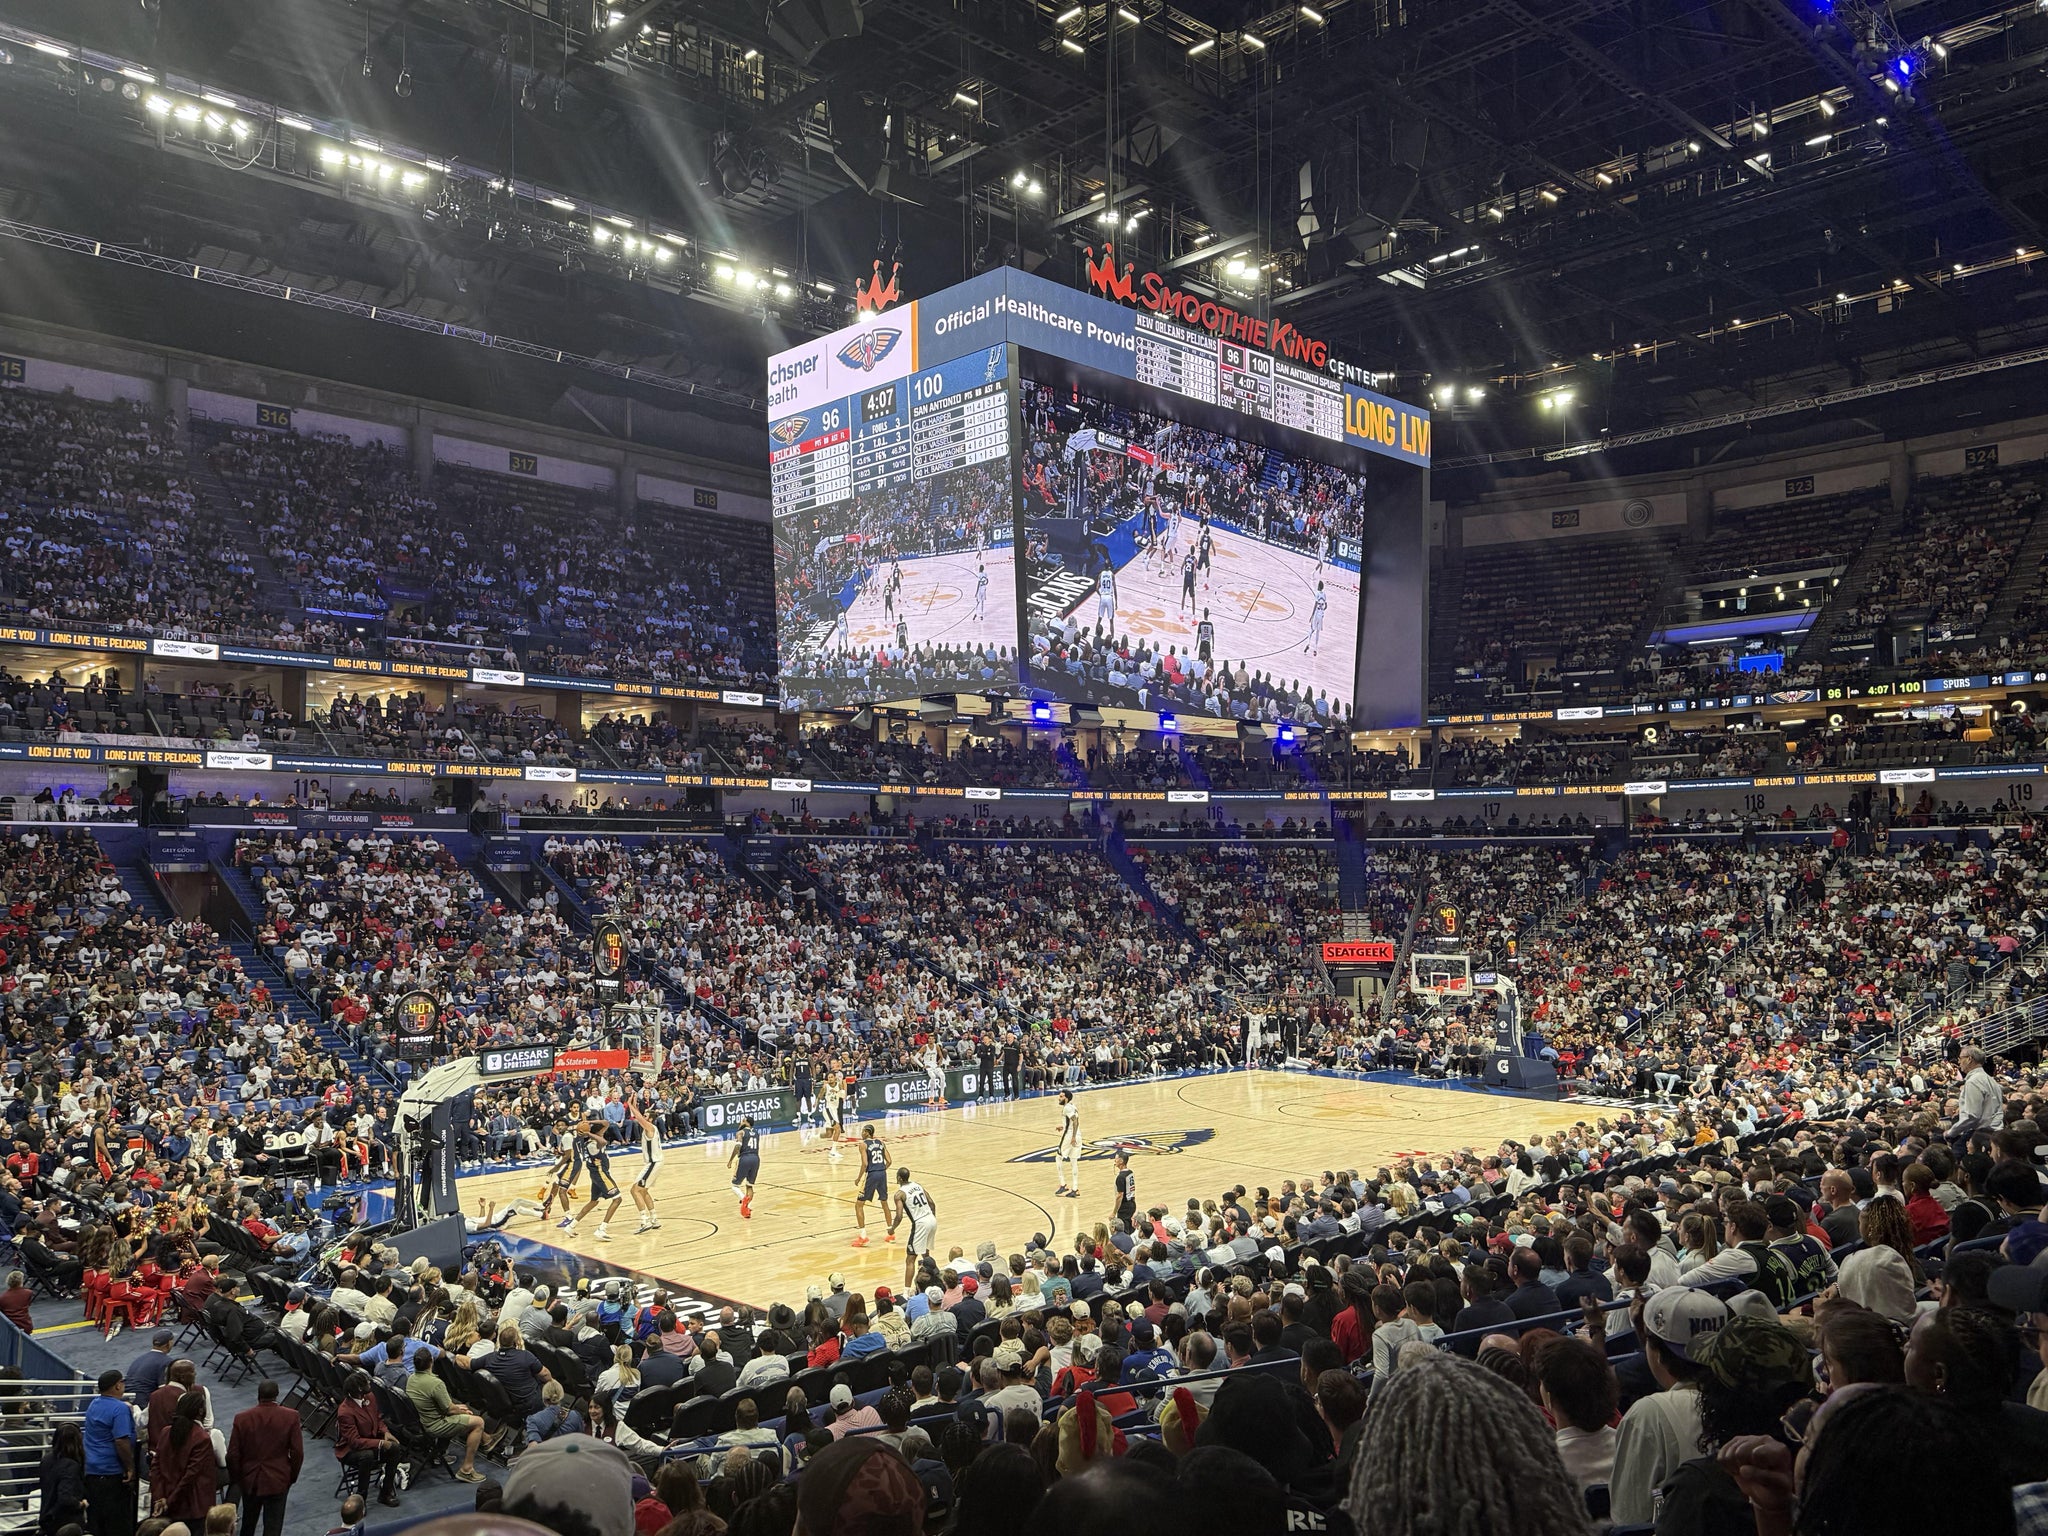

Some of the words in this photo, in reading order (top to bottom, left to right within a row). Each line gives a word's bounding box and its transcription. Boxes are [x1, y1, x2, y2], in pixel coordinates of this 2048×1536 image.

[1141, 272, 1269, 348] SMOOTHIE
[935, 300, 990, 335] Official
[995, 294, 1082, 334] Healthcare
[1087, 322, 1135, 351] Provid
[1137, 314, 1153, 329] NEW
[1155, 322, 1185, 340] ORLEANS
[1186, 331, 1216, 351] PELICANS
[1227, 349, 1239, 364] 96
[769, 354, 818, 386] chsner
[1252, 358, 1269, 374] 100
[1329, 358, 1378, 388] CENTER
[1238, 376, 1256, 390] 4:07
[1275, 362, 1288, 374] SAN
[1289, 366, 1318, 385] ANTONIO
[1319, 377, 1340, 391] SPURS
[914, 373, 943, 400] 100
[767, 383, 798, 406] ealth
[867, 388, 894, 411] 4:07
[913, 404, 929, 417] SAN
[929, 393, 962, 412] ANTONIO
[964, 392, 973, 400] PTS
[975, 388, 982, 397] RB
[984, 385, 993, 394] AST
[1221, 394, 1237, 404] FOULS
[260, 408, 288, 425] 316
[822, 408, 840, 432] 96
[928, 412, 952, 425] HARPER
[858, 429, 864, 439] 4
[872, 421, 888, 435] FOULS
[895, 418, 901, 428] 3
[928, 425, 951, 438] KORNET
[1345, 393, 1395, 446] LONG
[1401, 412, 1431, 458] LIV
[814, 439, 822, 447] PTS
[859, 442, 865, 453] 2
[895, 431, 901, 442] 3
[929, 437, 953, 449] VASSELL
[773, 444, 801, 463] PELICANS
[929, 445, 965, 460] CHAMPAGNIE
[1968, 449, 1996, 464] 324
[511, 457, 535, 471] 317
[878, 465, 885, 475] FT
[930, 460, 954, 473] BARNES
[1787, 479, 1813, 494] 323
[696, 492, 715, 505] 318
[1554, 512, 1578, 526] 322
[1102, 580, 1111, 589] 40
[0, 628, 16, 639] LIVE
[18, 629, 36, 641] YOU
[50, 632, 72, 644] LONG
[73, 634, 91, 646] LIVE
[92, 636, 108, 647] THE
[109, 638, 147, 651] PELICANS
[333, 658, 351, 668] LONG
[352, 659, 367, 669] LIVE
[368, 661, 382, 671] YOU
[392, 663, 410, 673] LONG
[410, 664, 424, 675] LIVE
[425, 666, 437, 676] THE
[438, 667, 468, 679] PELICANS
[614, 683, 628, 692] LONG
[629, 684, 640, 693] LIVE
[640, 685, 652, 694] YOU
[1827, 689, 1841, 698] 96
[1867, 685, 1888, 695] 4:07
[1899, 682, 1921, 693] 100
[1943, 678, 1970, 689] SPURS
[1992, 676, 2003, 684] 21
[2034, 673, 2046, 682] 49
[660, 686, 674, 695] LONG
[674, 688, 685, 697] LIVE
[686, 688, 695, 698] THE
[696, 690, 720, 700] PELICANS
[1721, 698, 1731, 706] 37
[1754, 696, 1764, 704] 21
[28, 746, 51, 757] LONG
[53, 747, 72, 758] LIVE
[73, 748, 91, 759] YOU
[104, 749, 127, 760] LONG
[128, 750, 146, 761] LIVE
[147, 751, 162, 762] THE
[164, 752, 202, 763] PELICANS
[387, 762, 405, 772] LONG
[406, 763, 421, 773] LIVE
[446, 764, 463, 774] LONG
[464, 765, 478, 775] LIVE
[479, 766, 491, 776] THE
[492, 766, 522, 777] PELICANS
[1754, 777, 1769, 787] LONG
[1770, 777, 1782, 786] LIVE
[1783, 776, 1795, 785] YOU
[1804, 775, 1819, 785] LONG
[1820, 775, 1833, 784] LIVE
[1834, 774, 1846, 783] THE
[1847, 773, 1876, 783] PELICANS
[580, 790, 598, 806] 113
[2008, 784, 2032, 801] 119
[791, 797, 807, 813] 114
[1744, 794, 1764, 810] 118
[973, 804, 989, 818] 115
[1206, 806, 1223, 820] 116
[1483, 803, 1500, 817] 117
[353, 815, 368, 823] RADIO
[1440, 907, 1456, 918] 4:07
[1447, 917, 1456, 932] 9
[1326, 946, 1390, 958] SEATGEEK
[602, 979, 620, 987] TISSOT
[409, 1003, 431, 1014] 4:07
[417, 1014, 426, 1027] 9
[503, 1049, 549, 1062] CAESARS
[503, 1059, 541, 1070] SPORTSBOOK
[1497, 1059, 1509, 1074] G
[726, 1097, 781, 1115] CAESARS
[747, 1137, 757, 1149] 41
[871, 1150, 883, 1164] 25
[912, 1192, 927, 1207] 40
